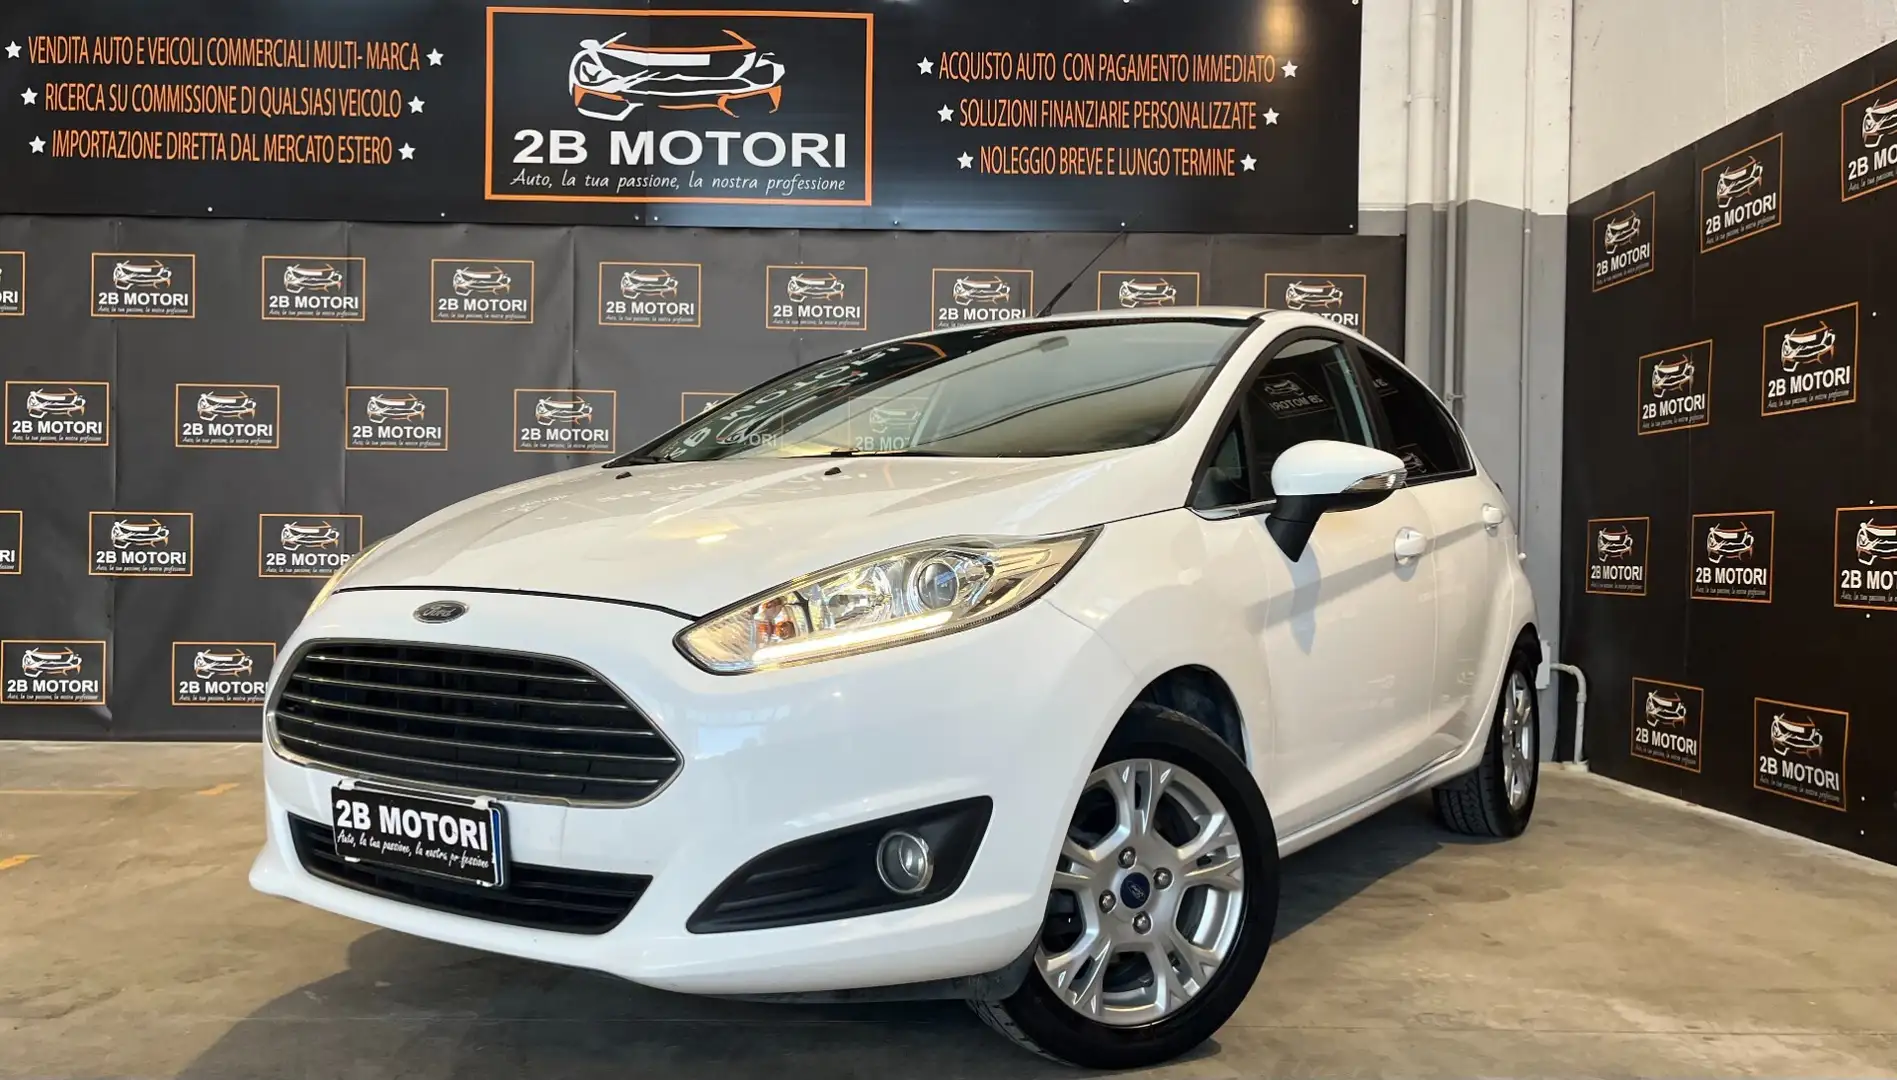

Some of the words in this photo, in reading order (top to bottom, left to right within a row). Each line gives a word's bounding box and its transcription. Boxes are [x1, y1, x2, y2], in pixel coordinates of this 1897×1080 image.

[28, 35, 90, 63] VENDITA
[93, 35, 133, 65] AUTO
[137, 38, 147, 66] E
[148, 37, 202, 66] VEICOLI
[207, 38, 311, 69] COMMERCIALI
[313, 40, 362, 70] MULTI-
[366, 41, 421, 72] MARCA
[940, 51, 1013, 83] ACQUISTO
[1015, 52, 1057, 81] AUTO
[1062, 53, 1096, 82] CON
[1098, 53, 1190, 83] PAGAMENTO
[1192, 54, 1276, 84] IMMEDIATO
[45, 82, 107, 112] RICERCA
[108, 84, 129, 113] SU
[130, 84, 238, 114] COMMISSIONE
[239, 86, 257, 114] DI
[259, 86, 336, 118] QUALSIASI
[339, 89, 402, 119] VEICOLO
[960, 98, 1038, 128] SOLUZIONI
[1040, 99, 1131, 130] FINANZIARIE
[1132, 100, 1258, 131] PERSONALIZZATE
[51, 129, 164, 160] IMPORTAZIONE
[166, 130, 227, 161] DIRETTA
[230, 132, 261, 163] DAL
[263, 133, 335, 164] MERCATO
[337, 135, 393, 165] ESTERO
[513, 129, 588, 165] 2B
[610, 130, 846, 168] MOTORI
[979, 144, 1057, 175] NOLEGGIO
[1058, 146, 1104, 176] BREVE
[1105, 148, 1116, 175] E
[1119, 148, 1171, 176] LUNGO
[1172, 147, 1237, 177] TERMINE
[1848, 156, 1869, 181] 2B
[510, 168, 553, 188] Auto,
[561, 169, 576, 187] la
[585, 174, 609, 187] tua
[617, 174, 680, 194] passione,
[689, 170, 703, 188] la
[711, 175, 758, 189] nostra
[765, 174, 845, 196] professione
[1705, 215, 1721, 235] 2B
[1724, 192, 1777, 228] MOTORI
[1596, 259, 1609, 277] 2B
[1610, 242, 1650, 271] MOTORI
[0, 290, 19, 304] RI
[98, 292, 119, 305] 2B
[123, 292, 189, 306] MOTORI
[269, 295, 290, 308] 2B
[294, 295, 359, 309] MOTORI
[438, 298, 459, 311] 2B
[463, 298, 527, 312] MOTORI
[606, 301, 627, 313] 2B
[631, 301, 695, 315] MOTORI
[773, 304, 793, 317] 2B
[798, 305, 861, 319] MOTORI
[938, 307, 959, 320] 2B
[963, 307, 1026, 321] MOTORI
[1767, 378, 1787, 398] 2B
[1790, 365, 1851, 394] MOTORI
[1642, 403, 1657, 420] 2B
[1659, 393, 1705, 417] MOTORI
[12, 420, 33, 433] 2B
[37, 420, 103, 435] MOTORI
[182, 422, 204, 436] 2B
[208, 423, 273, 437] MOTORI
[352, 425, 373, 438] 2B
[377, 425, 441, 439] MOTORI
[521, 427, 541, 441] 2B
[546, 428, 609, 442] MOTORI
[96, 550, 117, 564] 2B
[121, 551, 187, 565] MOTORI
[266, 553, 287, 566] 2B
[291, 553, 355, 566] MOTOR
[1590, 563, 1601, 579] 2B
[1602, 565, 1643, 581] MOTORI
[1695, 567, 1712, 584] 2B
[1715, 567, 1767, 586] MOTORI
[1841, 569, 1862, 589] 2B
[422, 604, 457, 618] Ford
[7, 679, 28, 693] 2B
[32, 679, 99, 693] MOTORI
[179, 681, 201, 694] 2B
[1635, 727, 1649, 744] 2B
[1651, 730, 1697, 756] MOTORI
[1759, 755, 1778, 775] 2B
[1781, 759, 1840, 791] MOTORI
[335, 799, 371, 831] 2B
[378, 804, 488, 852] MOTORI
[337, 828, 357, 847] Auto,
[359, 832, 368, 846] la
[369, 839, 381, 849] tua
[382, 840, 412, 858] passione,
[415, 841, 424, 856] la
[425, 848, 449, 861] nostra
